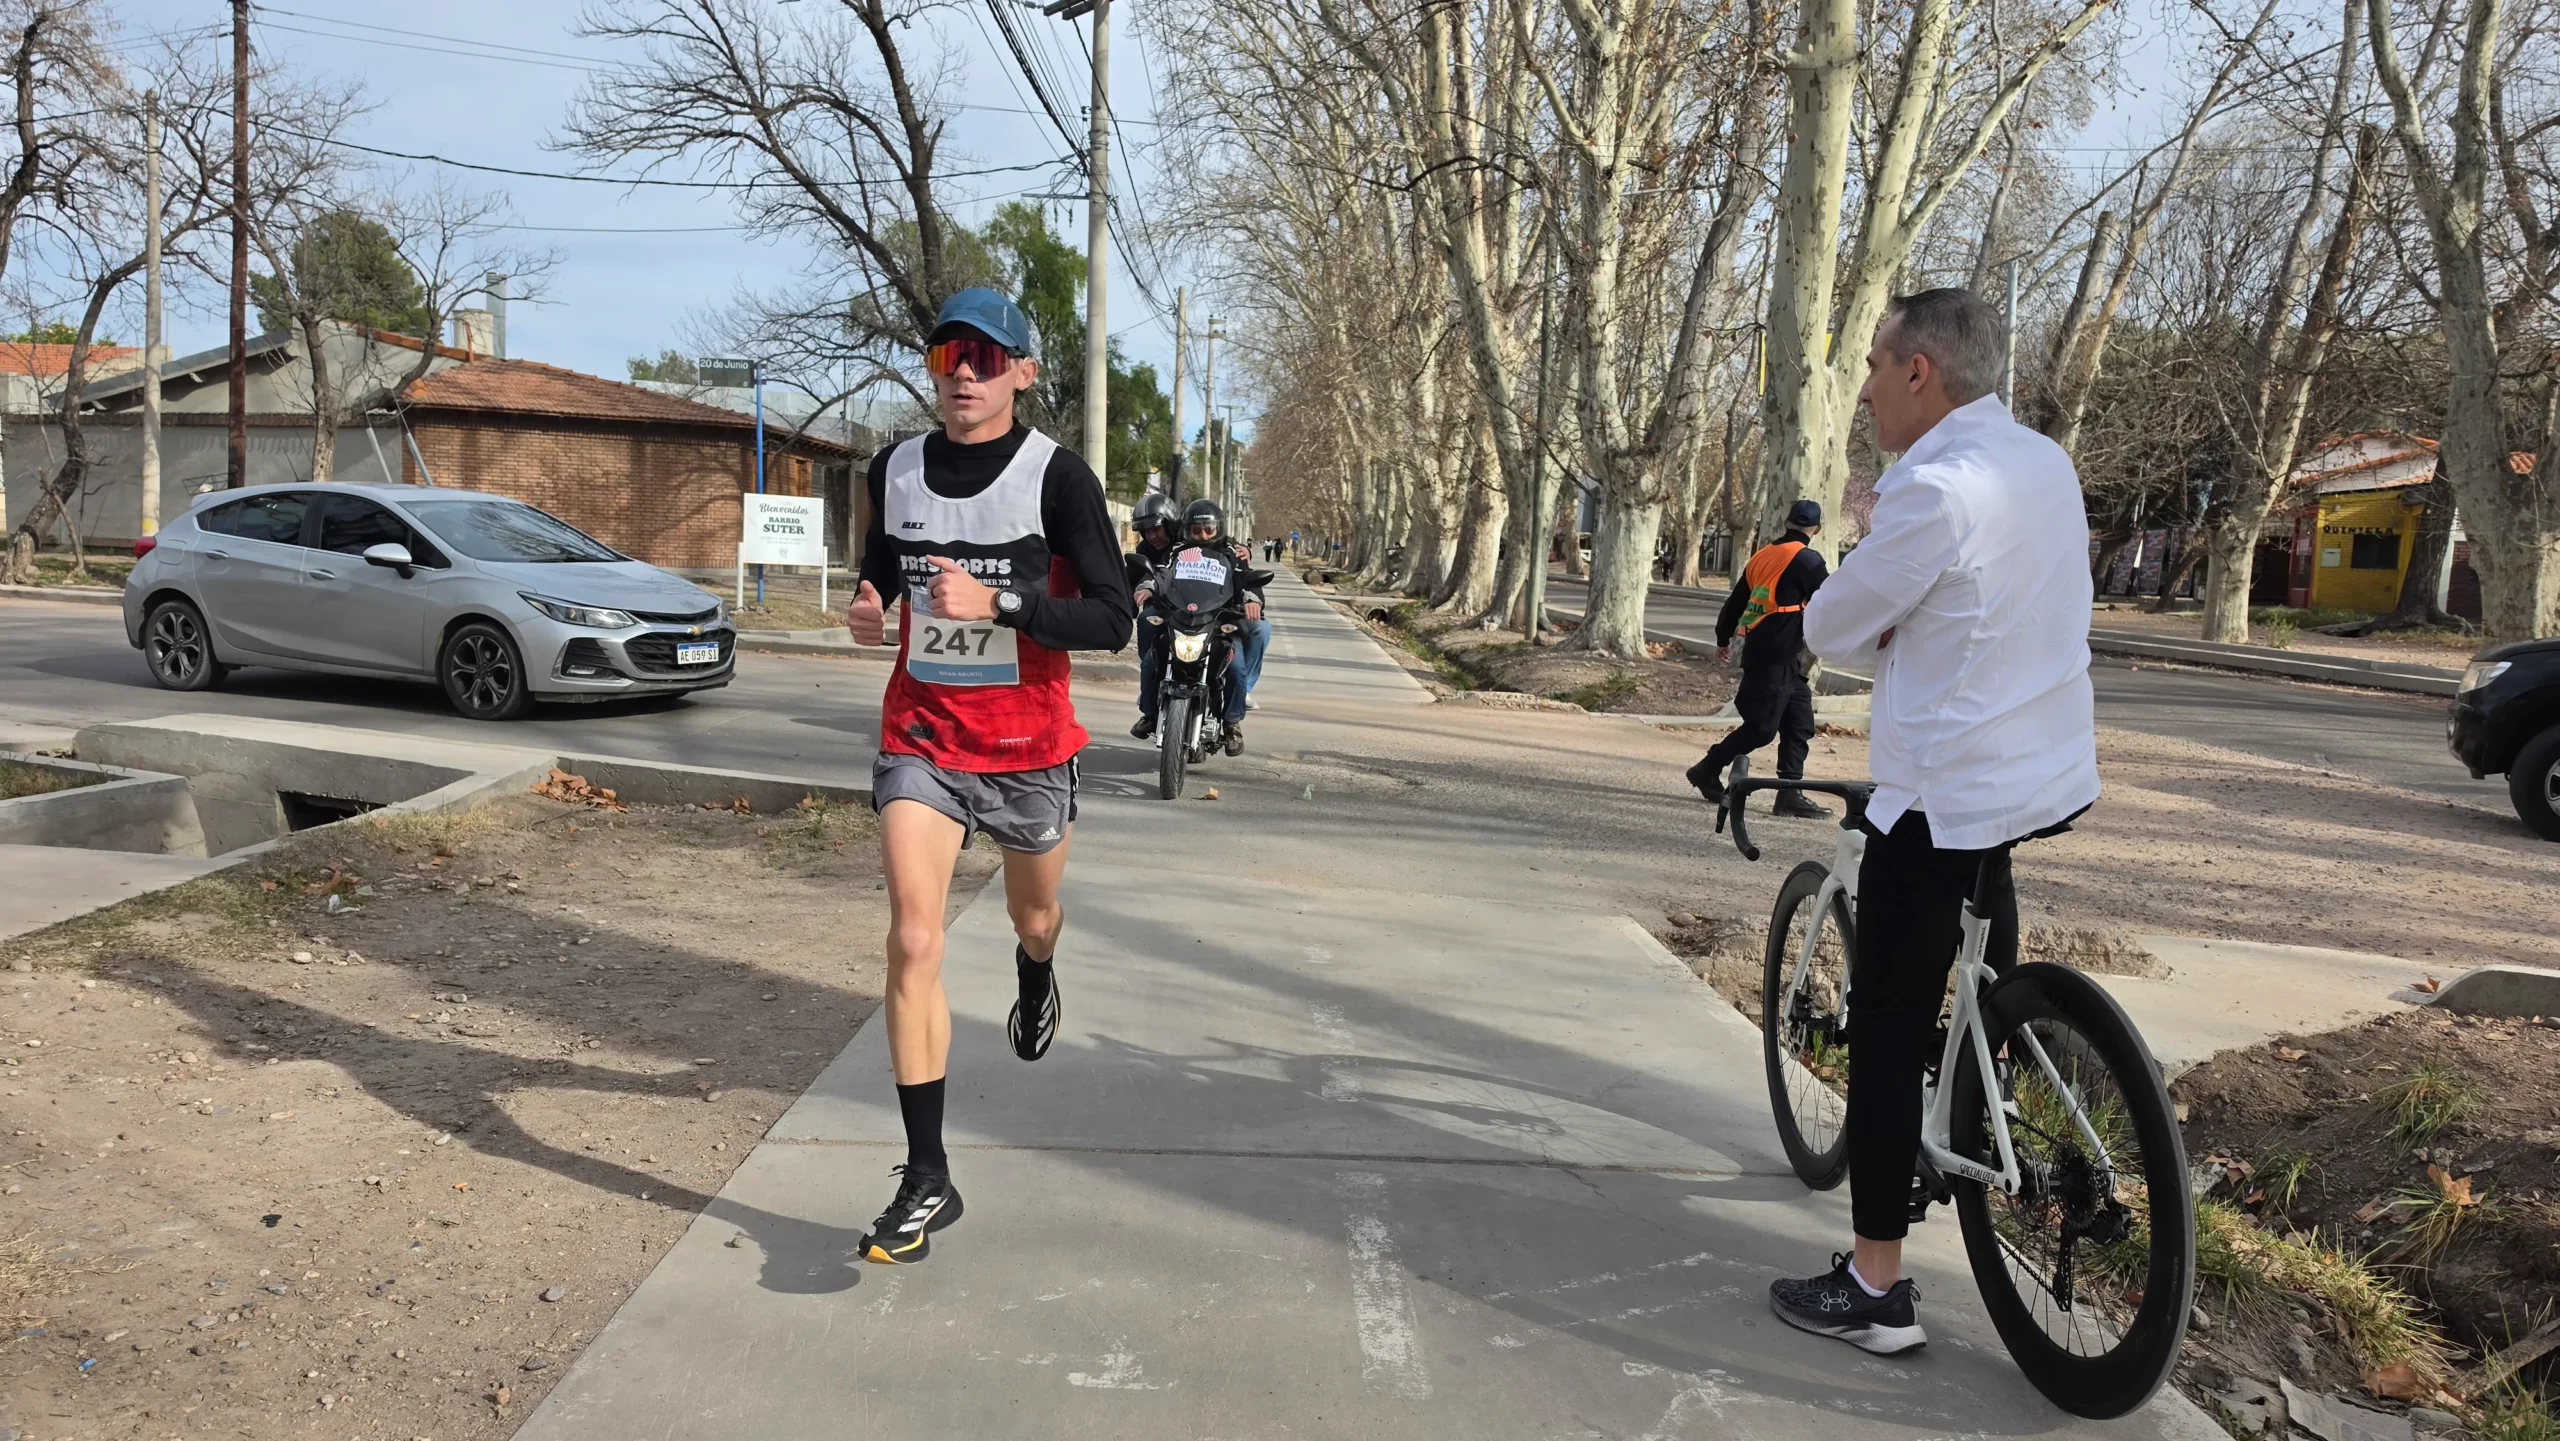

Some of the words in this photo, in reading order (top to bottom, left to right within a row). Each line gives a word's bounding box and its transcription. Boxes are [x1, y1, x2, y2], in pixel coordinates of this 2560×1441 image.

[700, 359, 712, 368] 20
[713, 359, 724, 369] de
[724, 360, 749, 370] Junio
[759, 503, 809, 515] Bienvenidos
[768, 516, 800, 524] BARRIO
[763, 524, 805, 535] SUTER
[2323, 525, 2393, 534] QUINIELA
[923, 625, 994, 656] 247
[681, 651, 690, 661] AE
[692, 650, 706, 661] 059
[1960, 1163, 1996, 1184] SPECIALIZED
